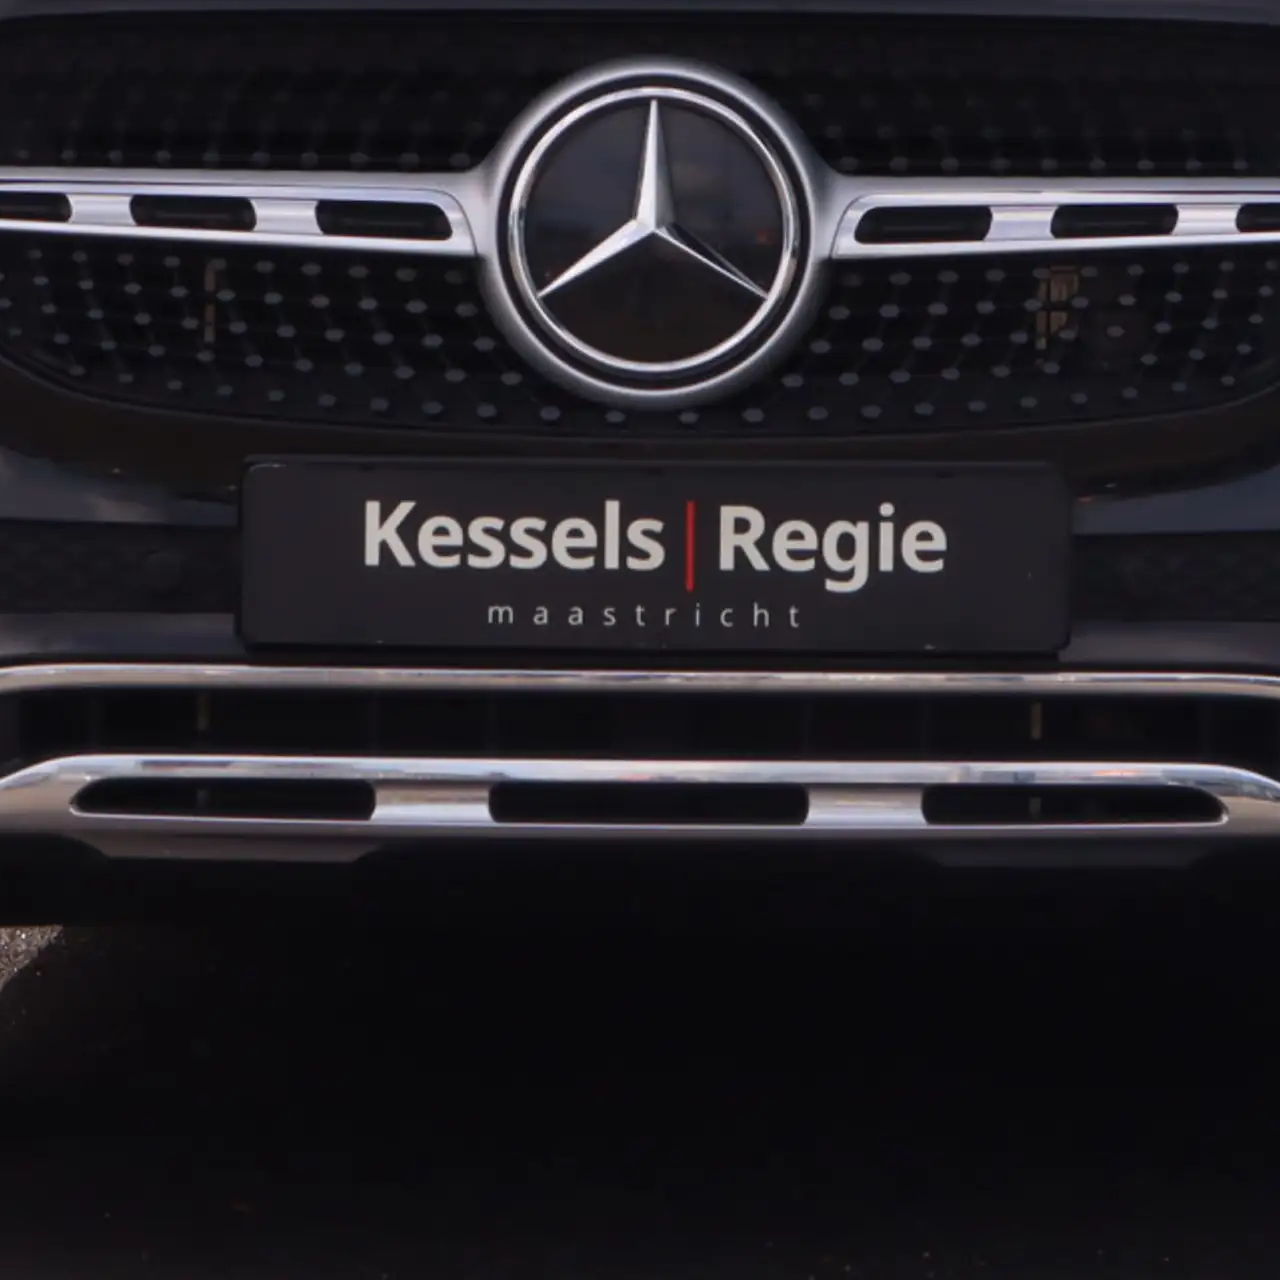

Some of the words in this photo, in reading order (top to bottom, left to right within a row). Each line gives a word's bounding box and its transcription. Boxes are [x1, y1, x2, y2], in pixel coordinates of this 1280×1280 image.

[364, 500, 666, 570] Kessels
[719, 503, 948, 593] Regie
[487, 602, 800, 628] maastricht
